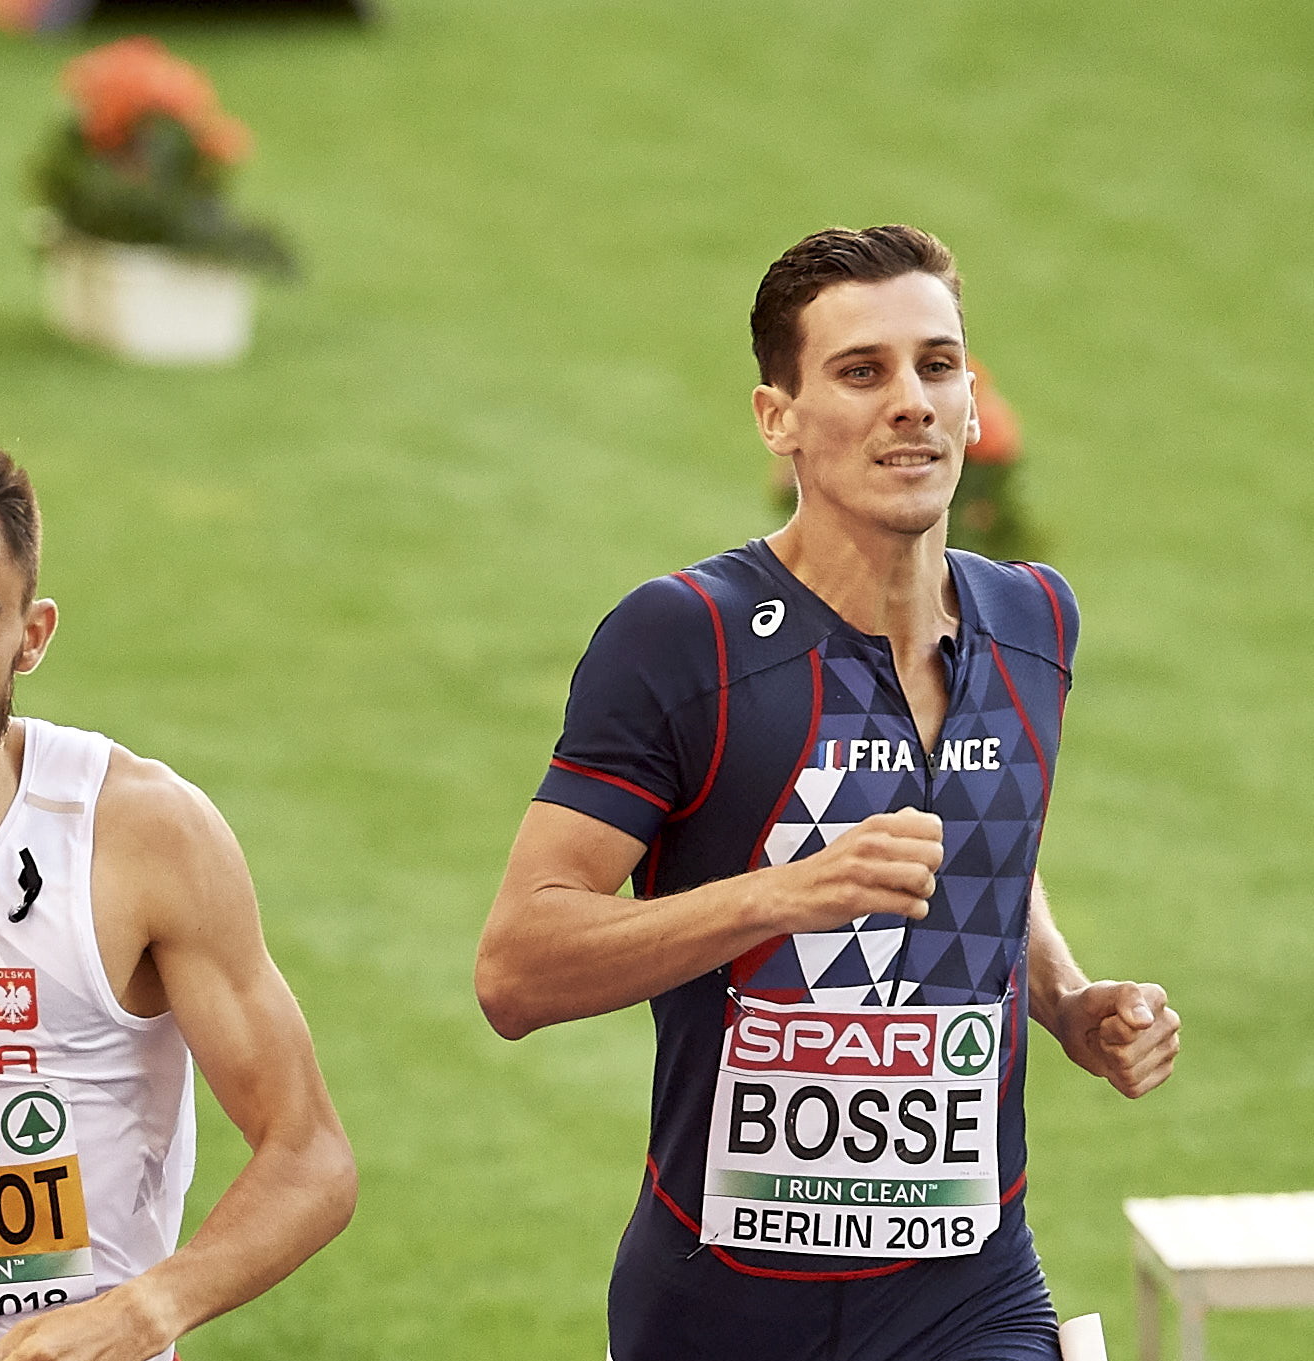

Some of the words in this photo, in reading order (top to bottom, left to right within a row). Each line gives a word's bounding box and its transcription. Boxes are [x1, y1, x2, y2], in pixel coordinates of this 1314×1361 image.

[848, 738, 1001, 772] FRANCE
[735, 1021, 933, 1068] SPAR
[727, 1080, 983, 1165] BOSSE
[774, 1179, 781, 1198] I
[788, 1179, 843, 1202] RUN
[732, 1207, 873, 1249] BERLIN
[885, 1215, 976, 1249] 2018
